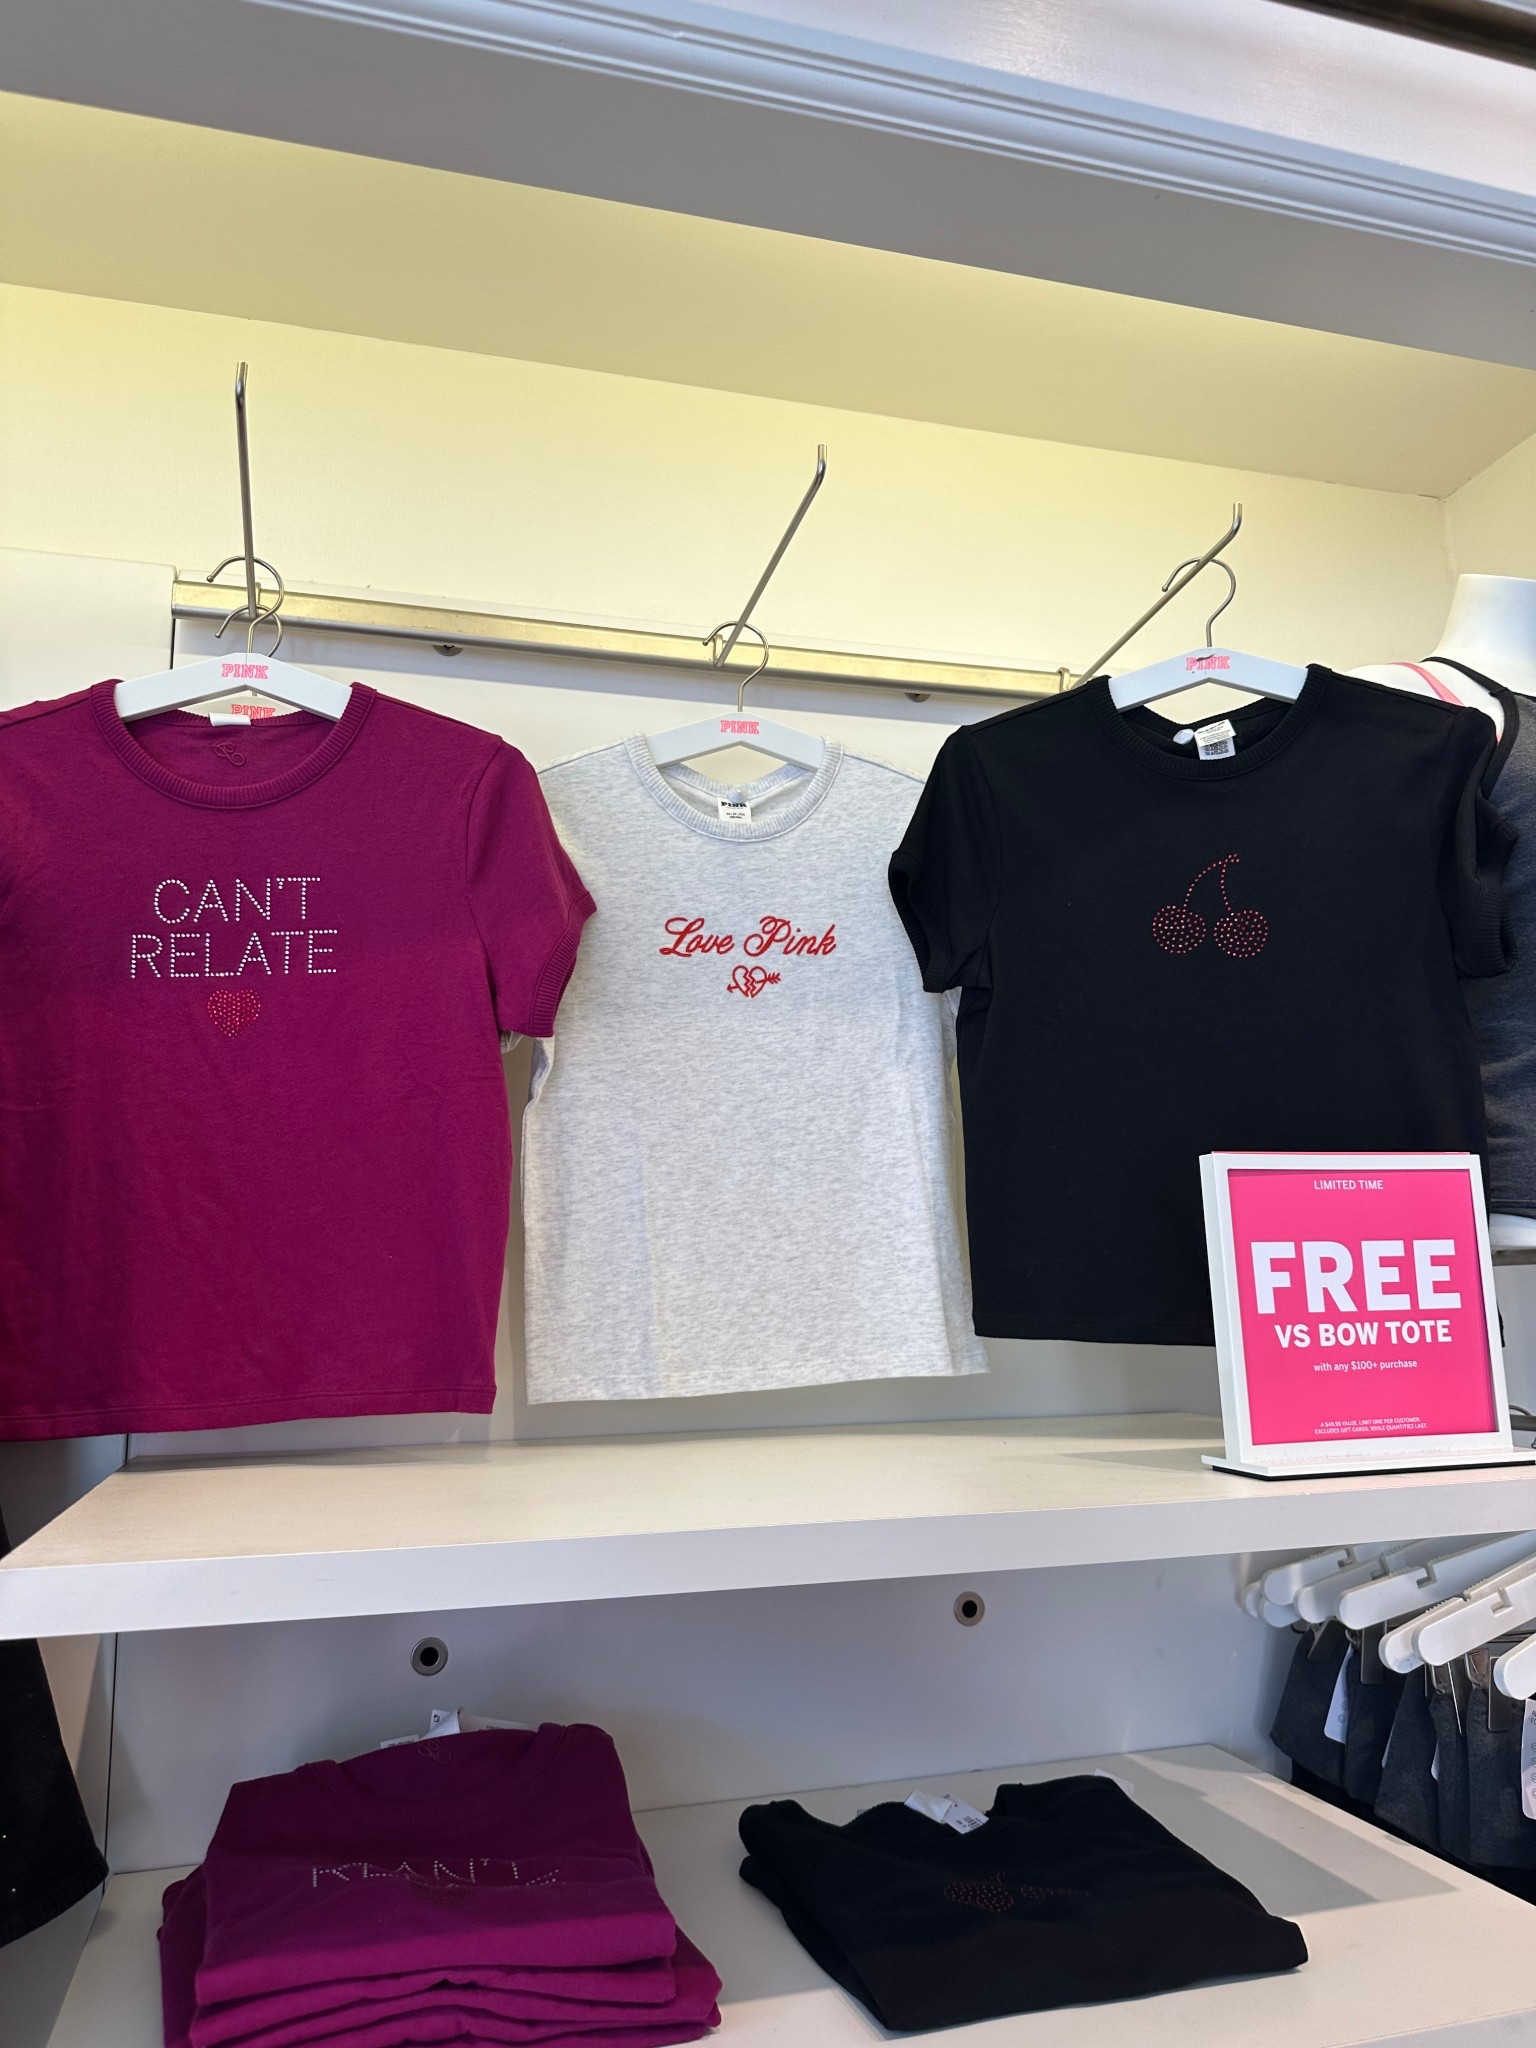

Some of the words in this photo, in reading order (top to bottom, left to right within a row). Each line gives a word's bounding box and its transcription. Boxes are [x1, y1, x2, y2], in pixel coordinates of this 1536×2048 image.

[222, 663, 269, 679] PINK
[1186, 655, 1230, 671] PINK
[720, 720, 760, 735] PINK
[153, 877, 321, 924] CAN'T
[658, 916, 735, 957] Love
[743, 915, 837, 957] Pink
[130, 929, 338, 979] RELATE
[1313, 1179, 1357, 1190] LIMITED
[1358, 1179, 1384, 1190] TIME
[1250, 1239, 1462, 1315] FREE
[1274, 1323, 1311, 1348] VS
[1318, 1322, 1379, 1347] BOW
[1385, 1319, 1453, 1345] TOTE
[1313, 1362, 1332, 1372] with
[1334, 1363, 1349, 1373] any
[1350, 1360, 1377, 1370] $100+
[1380, 1360, 1418, 1370] purchase
[1314, 1427, 1340, 1435] EXCLUDES
[1386, 1423, 1415, 1432] QUANTITIES
